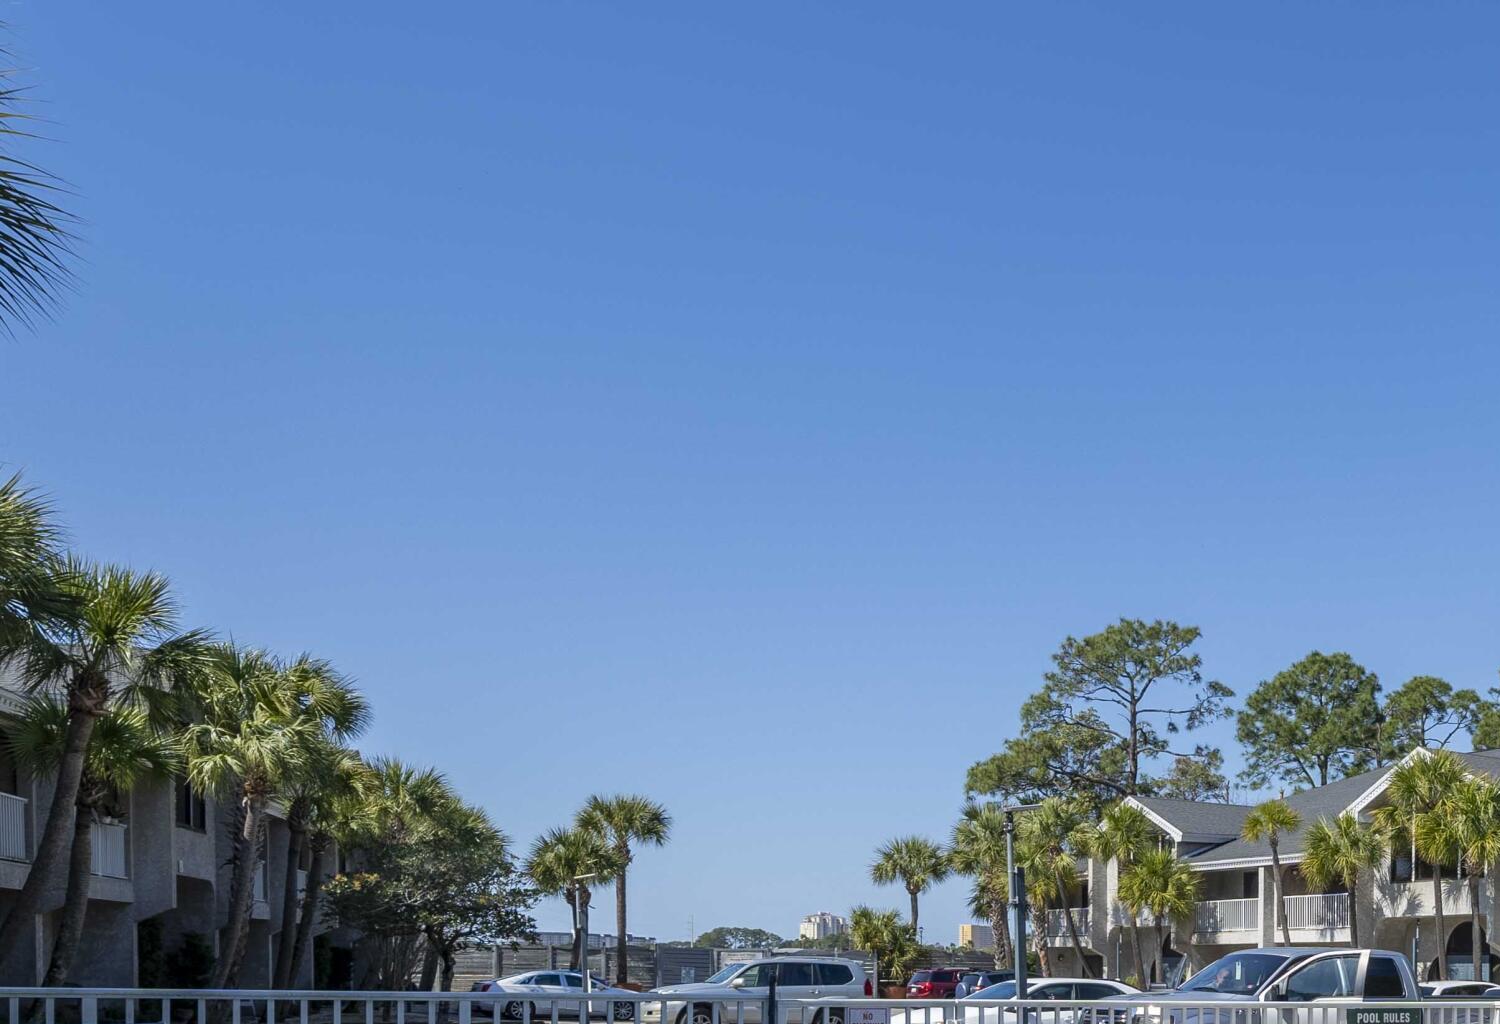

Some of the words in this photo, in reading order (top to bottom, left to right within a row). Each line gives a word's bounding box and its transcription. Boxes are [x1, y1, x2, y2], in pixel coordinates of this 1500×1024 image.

[863, 1012, 873, 1020] NO
[1357, 1012, 1380, 1024] POOL
[1383, 1012, 1411, 1023] RULES
